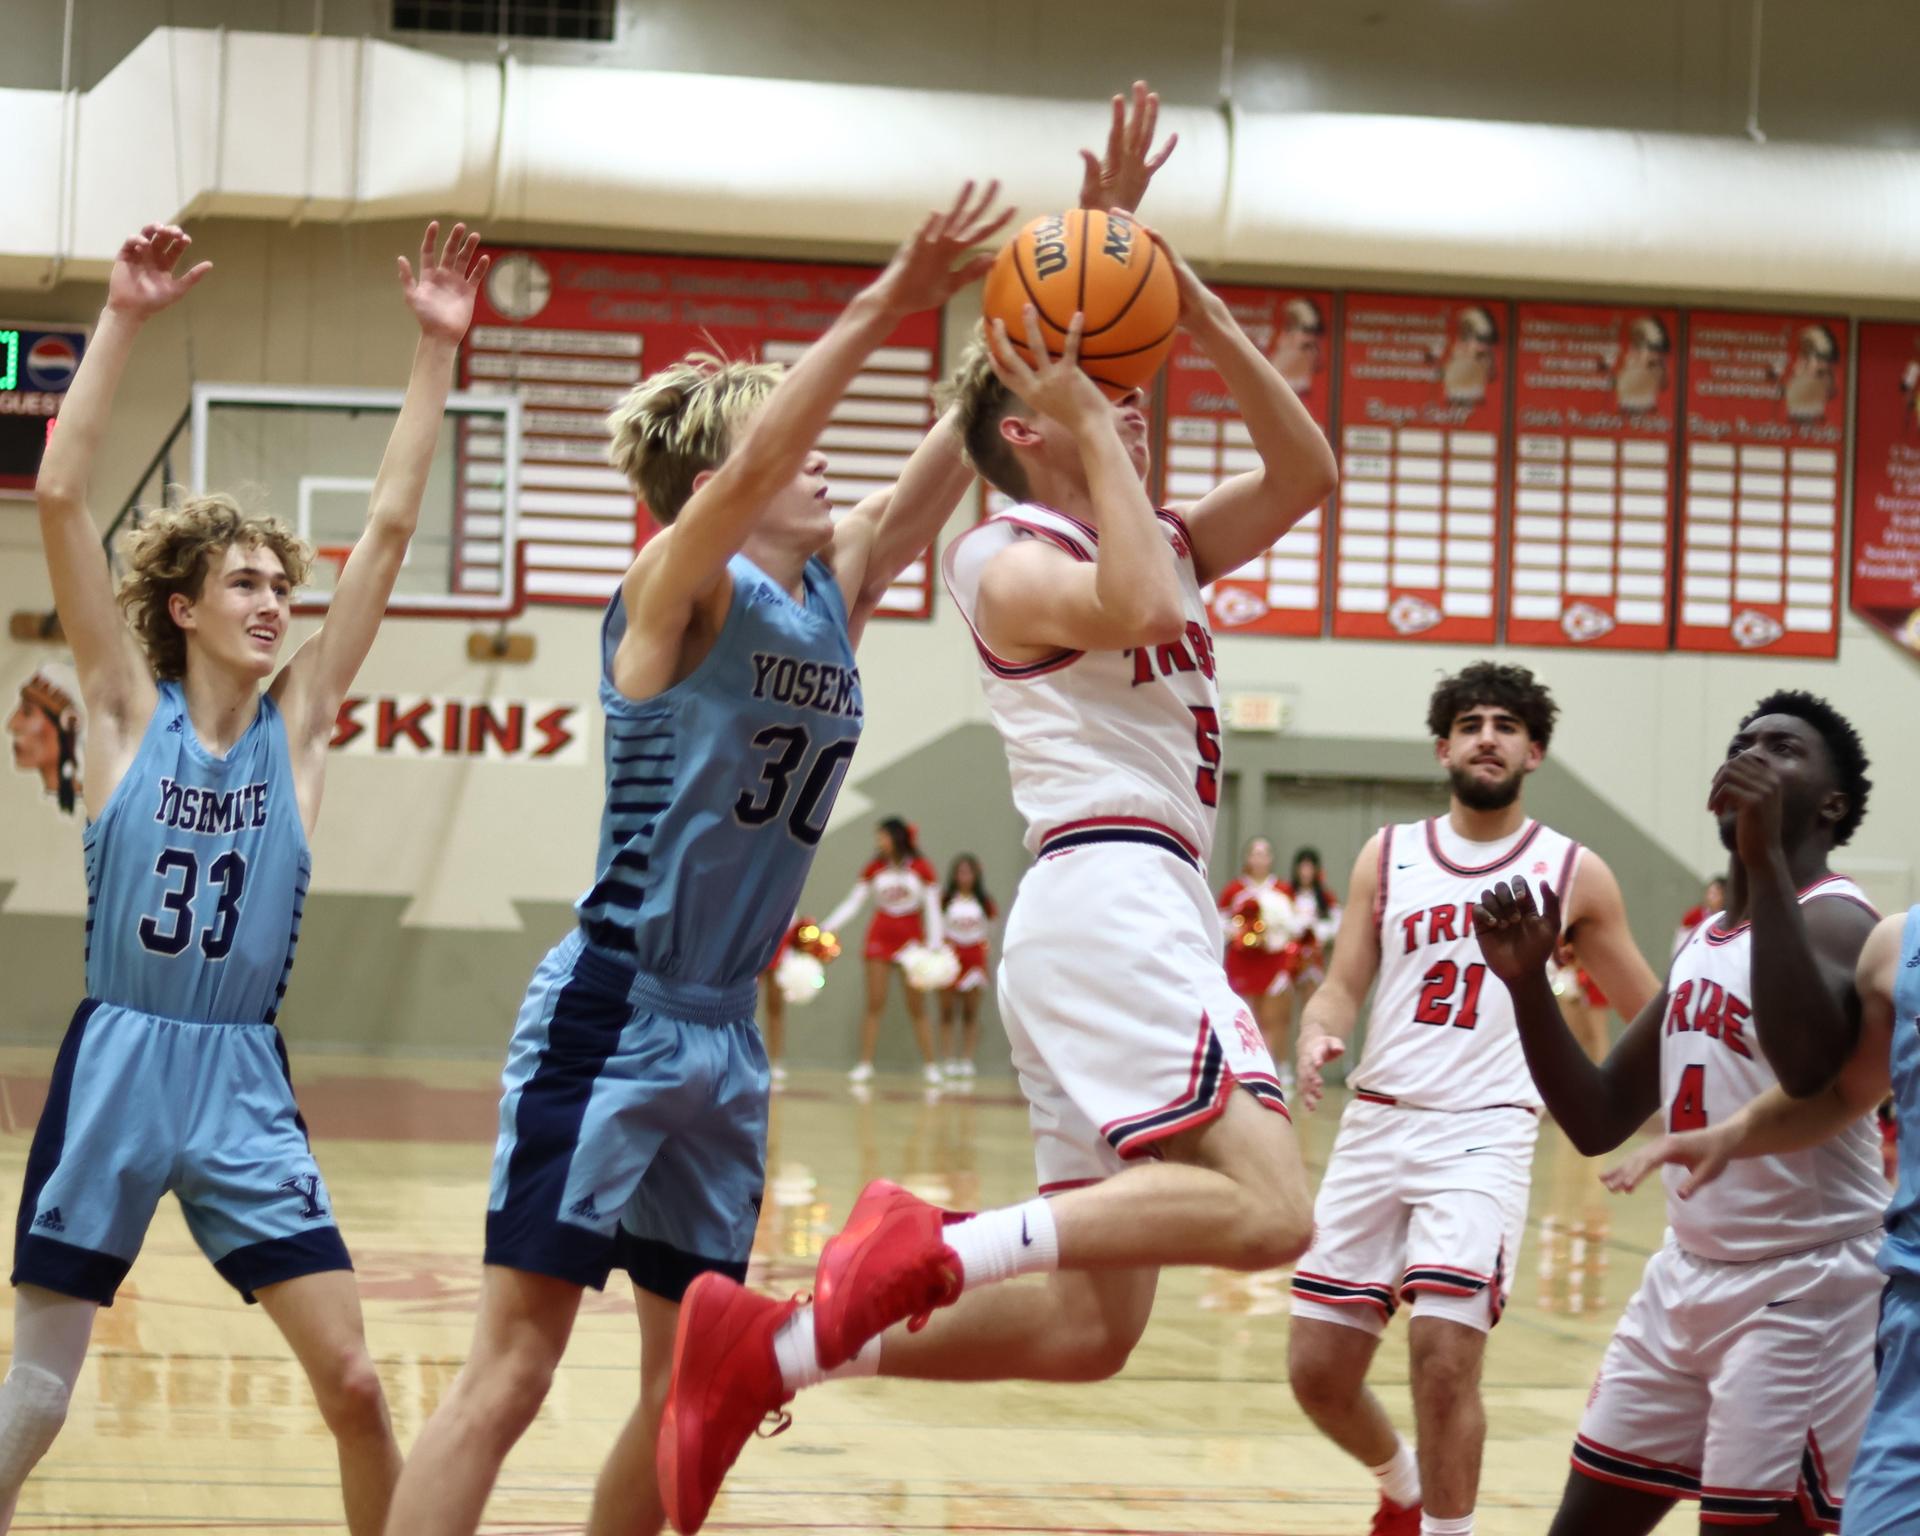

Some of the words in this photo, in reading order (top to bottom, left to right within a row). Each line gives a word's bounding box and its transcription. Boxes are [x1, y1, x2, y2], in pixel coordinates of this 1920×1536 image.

[753, 653, 864, 717] YOSEM
[734, 724, 858, 846] 30
[137, 847, 247, 961] 33
[1413, 959, 1487, 1030] 21
[1669, 1063, 1709, 1135] 4
